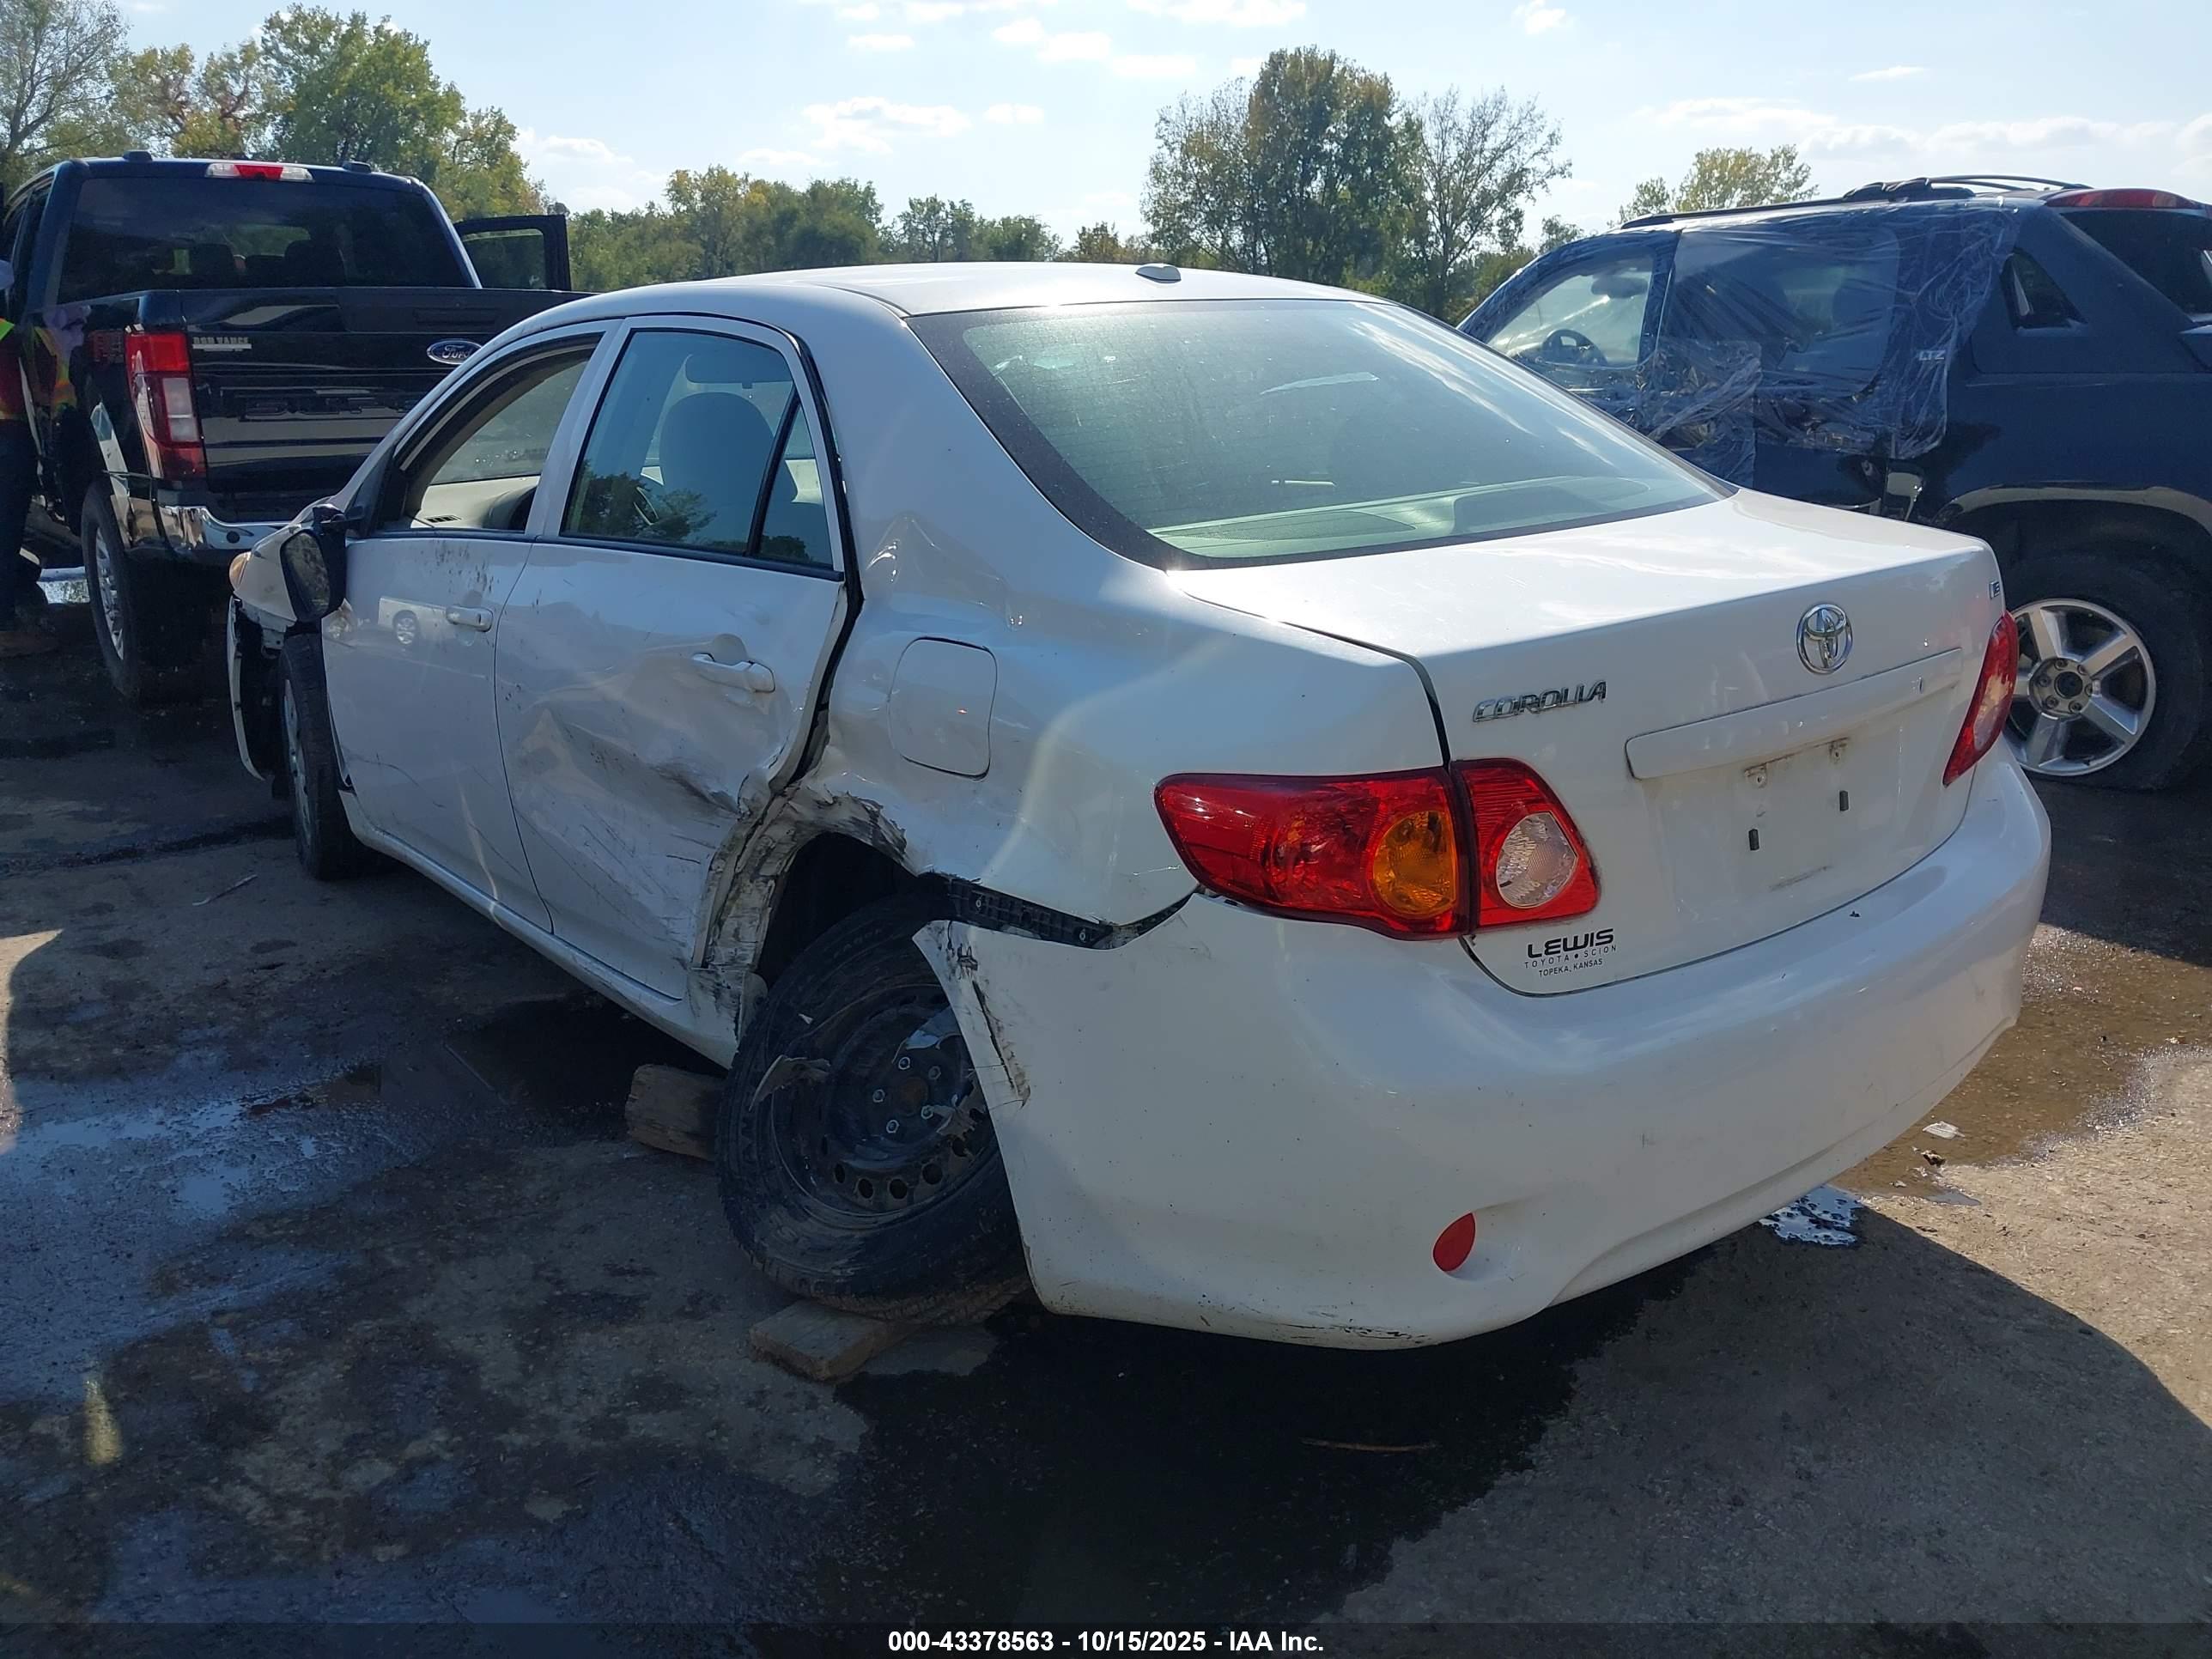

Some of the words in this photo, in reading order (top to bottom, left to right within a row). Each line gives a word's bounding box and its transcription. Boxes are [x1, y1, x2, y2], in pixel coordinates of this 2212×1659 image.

[1918, 350, 1946, 361] LTZ
[1473, 679, 1607, 722] COROLLA
[1528, 928, 1614, 959] LEWIS
[1525, 955, 1570, 969] TOYOTA
[1583, 945, 1617, 958] SCION
[1539, 966, 1572, 977] TOPEKA,
[1573, 958, 1603, 970] KANSAS
